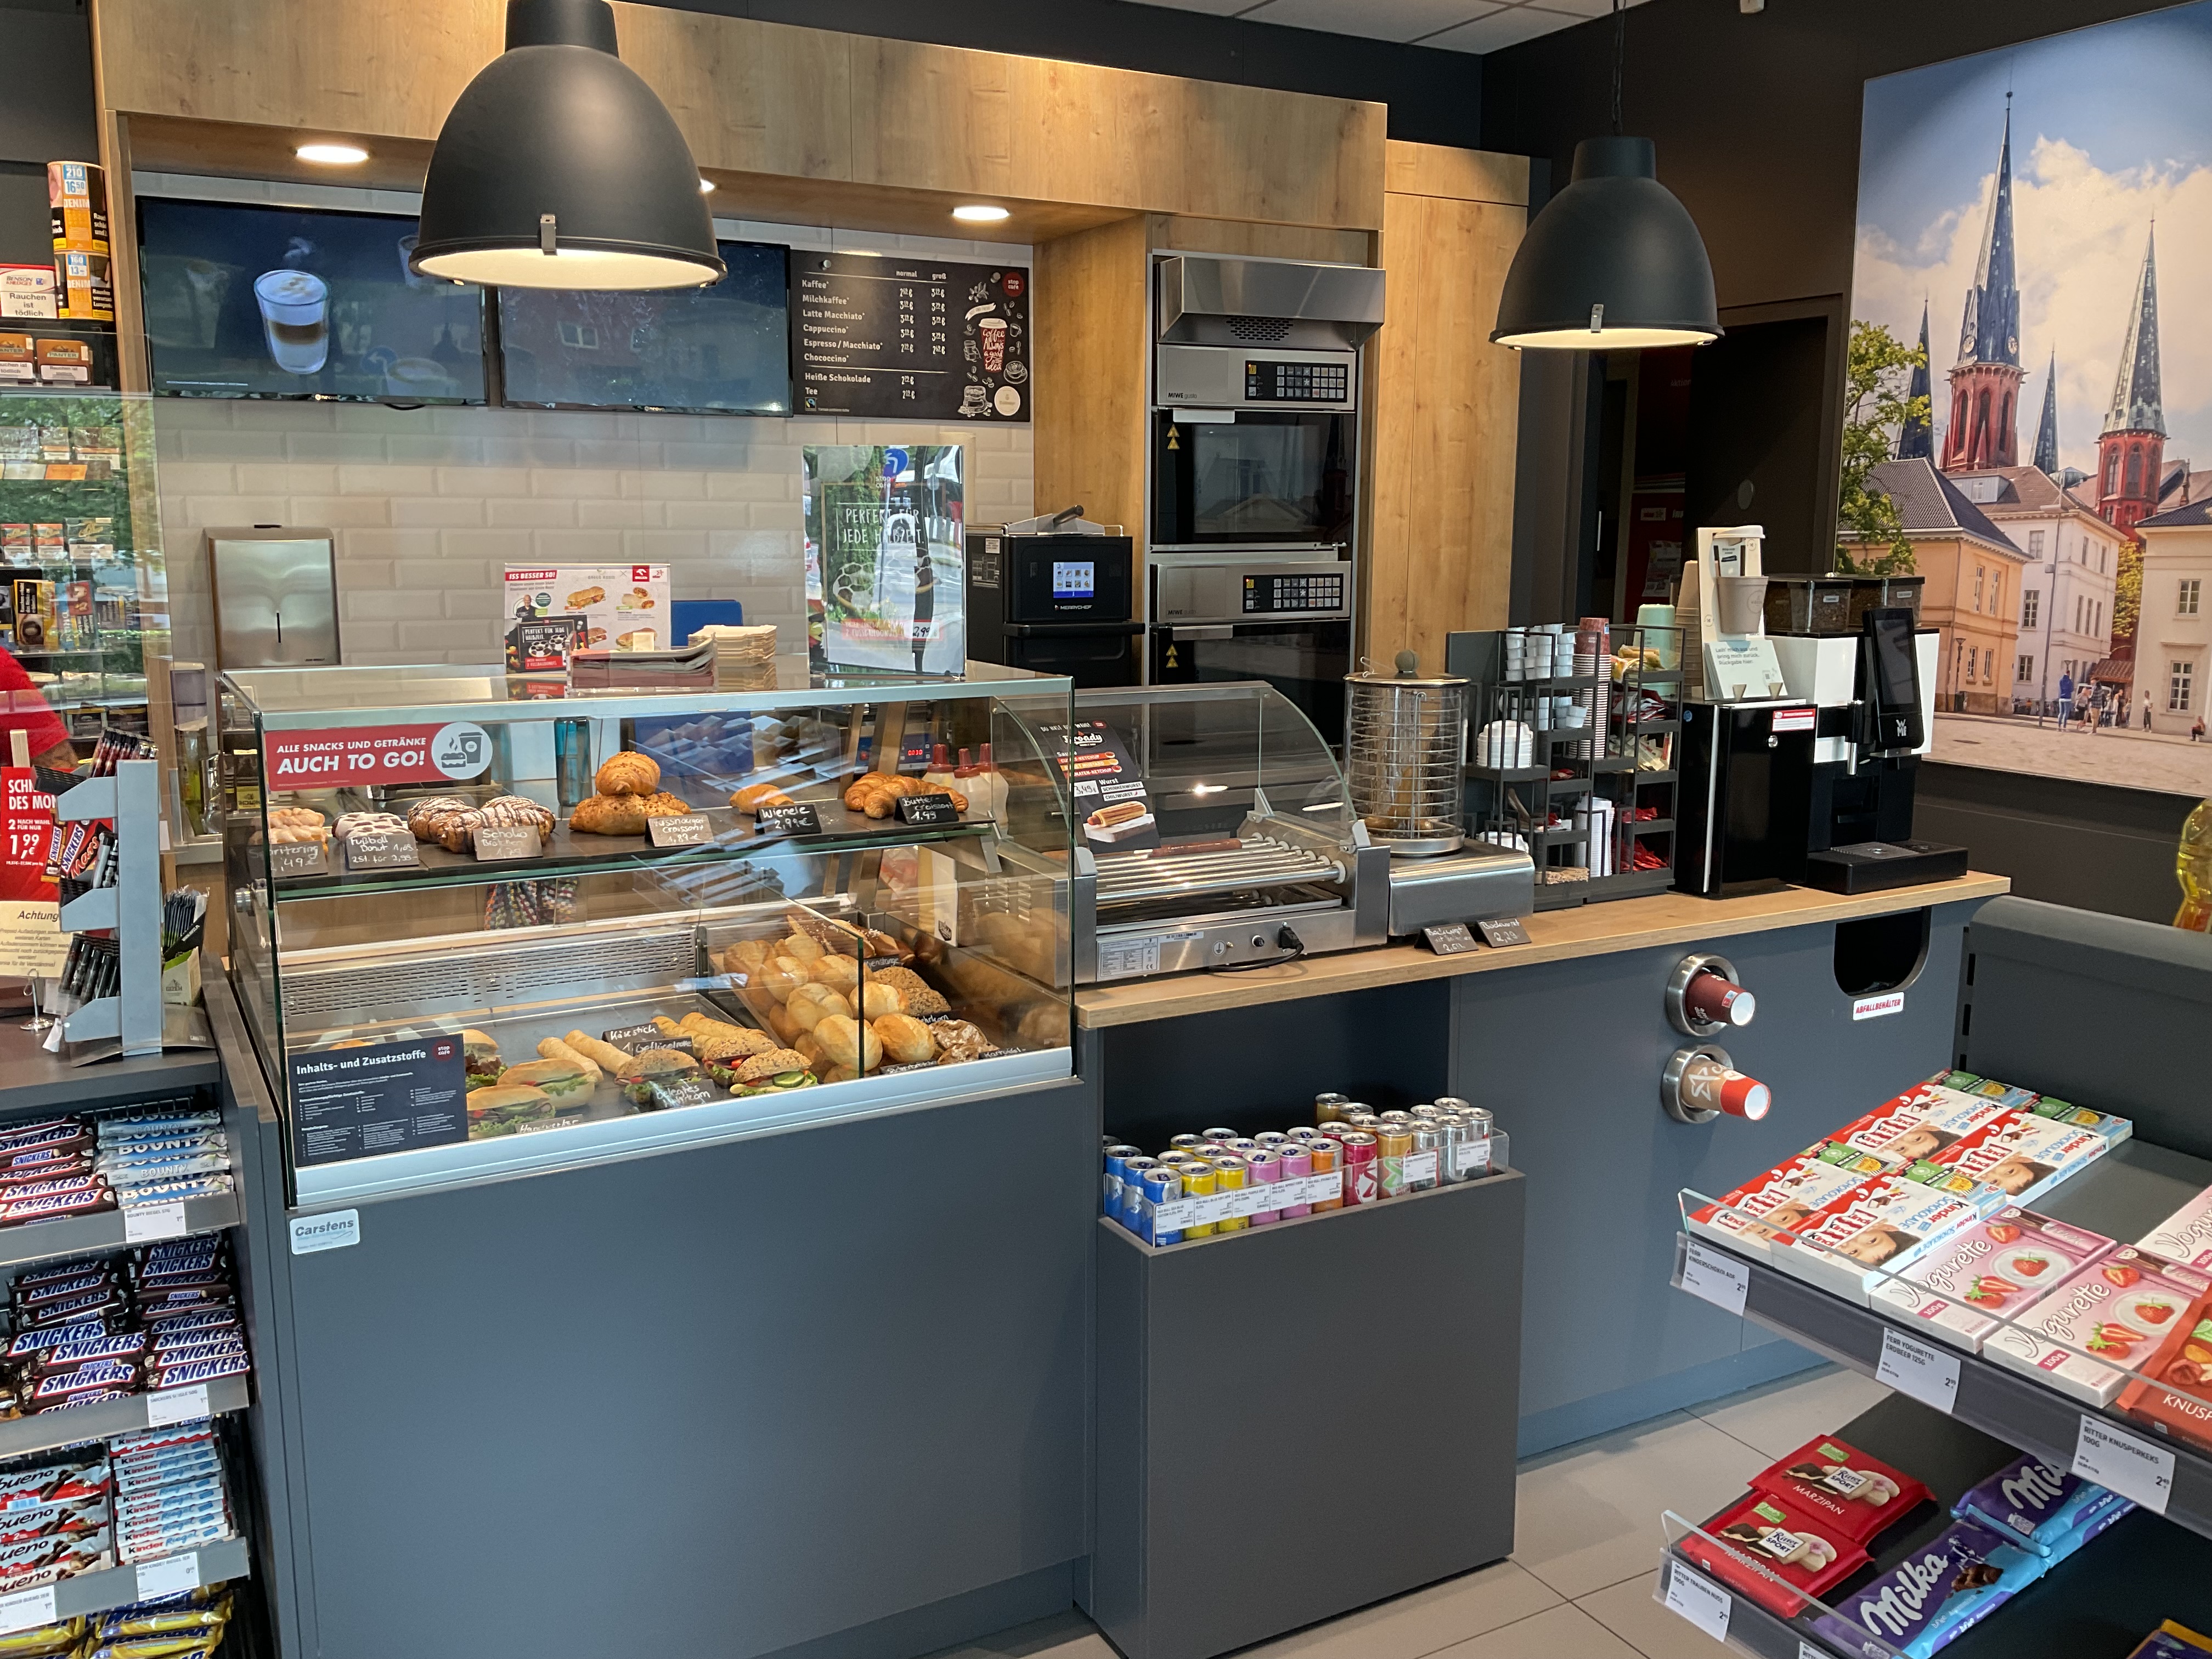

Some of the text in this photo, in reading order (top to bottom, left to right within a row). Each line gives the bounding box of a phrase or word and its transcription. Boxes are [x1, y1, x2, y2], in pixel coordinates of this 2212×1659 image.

[64, 199, 89, 208] DENIM
[67, 280, 91, 288] DENIM
[803, 309, 822, 318] Latte
[804, 338, 836, 348] Espresso
[985, 363, 1001, 371] idea
[805, 373, 871, 383] Heiße Schokolade
[843, 528, 868, 543] JEDE
[277, 737, 426, 753] ALLE SNACKS UND GETRÄNKE
[277, 751, 425, 775] AUCH TO GO!
[1103, 783, 1141, 792] SCHINKENWURST
[9, 796, 28, 809] DES
[8, 819, 15, 830] 2
[50, 828, 61, 861] SNICKERS
[61, 826, 84, 870] SNICKERS
[72, 836, 99, 878] Mars
[17, 911, 59, 922] Achtung
[1855, 998, 1901, 1015] ABFALLBEHÄLTER
[296, 1049, 426, 1075] Inhalts- und Zusatzstoffe
[119, 1136, 207, 1155] BOUNTY
[2063, 1133, 2098, 1154] Kinder
[14, 1151, 51, 1165] SNICKERS
[141, 1164, 187, 1177] BOUNTY
[6, 1176, 92, 1198] SNICKERS
[122, 1177, 215, 1200] BOUNTY
[1809, 1176, 1864, 1207] SCHOKOLADE
[11, 1190, 97, 1212] SNICKERS
[1898, 1197, 1969, 1230] Kinder SCHOKOLADE
[295, 1218, 354, 1237] Carstens
[151, 1238, 217, 1260] SNICKERS
[145, 1254, 211, 1276] SNICKERS
[1889, 1239, 1993, 1308] Yogurette
[31, 1274, 101, 1299] SNICKERS
[41, 1290, 108, 1318] SNICKERS
[170, 1291, 199, 1300] SNICKERS
[1923, 1301, 1946, 1317] 100g
[153, 1310, 236, 1333] SNICKERS
[2005, 1283, 2111, 1359] Yogurette
[15, 1321, 105, 1352] SNICKERS
[55, 1334, 146, 1361] SNICKERS
[163, 1340, 243, 1363] SNICKERS
[1886, 1343, 1926, 1365] ERDBEER 125G
[1887, 1335, 1935, 1362] FERR YOGURETTE
[81, 1359, 114, 1370] SNICKERS
[164, 1351, 249, 1384] SNICKERS
[2042, 1352, 2067, 1370] 100g
[42, 1365, 133, 1393] SNICKERS
[69, 1390, 102, 1402] SNICKERS
[119, 1435, 151, 1445] Kinder
[2083, 1435, 2100, 1448] 100G
[2084, 1426, 2159, 1464] RITTER KNUSPERKEKS
[122, 1453, 155, 1464] Kinder
[124, 1464, 157, 1476] Kinder
[1837, 1469, 1864, 1486] Ritter
[1830, 1474, 1855, 1491] SPORT
[123, 1492, 157, 1503] Kinder
[1792, 1485, 1846, 1516] MARZIPAN
[126, 1503, 160, 1514] Kinder
[125, 1516, 159, 1528] Kinder
[126, 1529, 160, 1541] Kinder
[1774, 1531, 1800, 1547] Ritter
[129, 1542, 163, 1554] Kinder
[1765, 1536, 1791, 1553] SPORT
[1674, 1576, 1685, 1586] 100G
[1674, 1568, 1723, 1604] RITTER TRAUBEN NUSS
[1860, 1553, 1949, 1637] Milka
